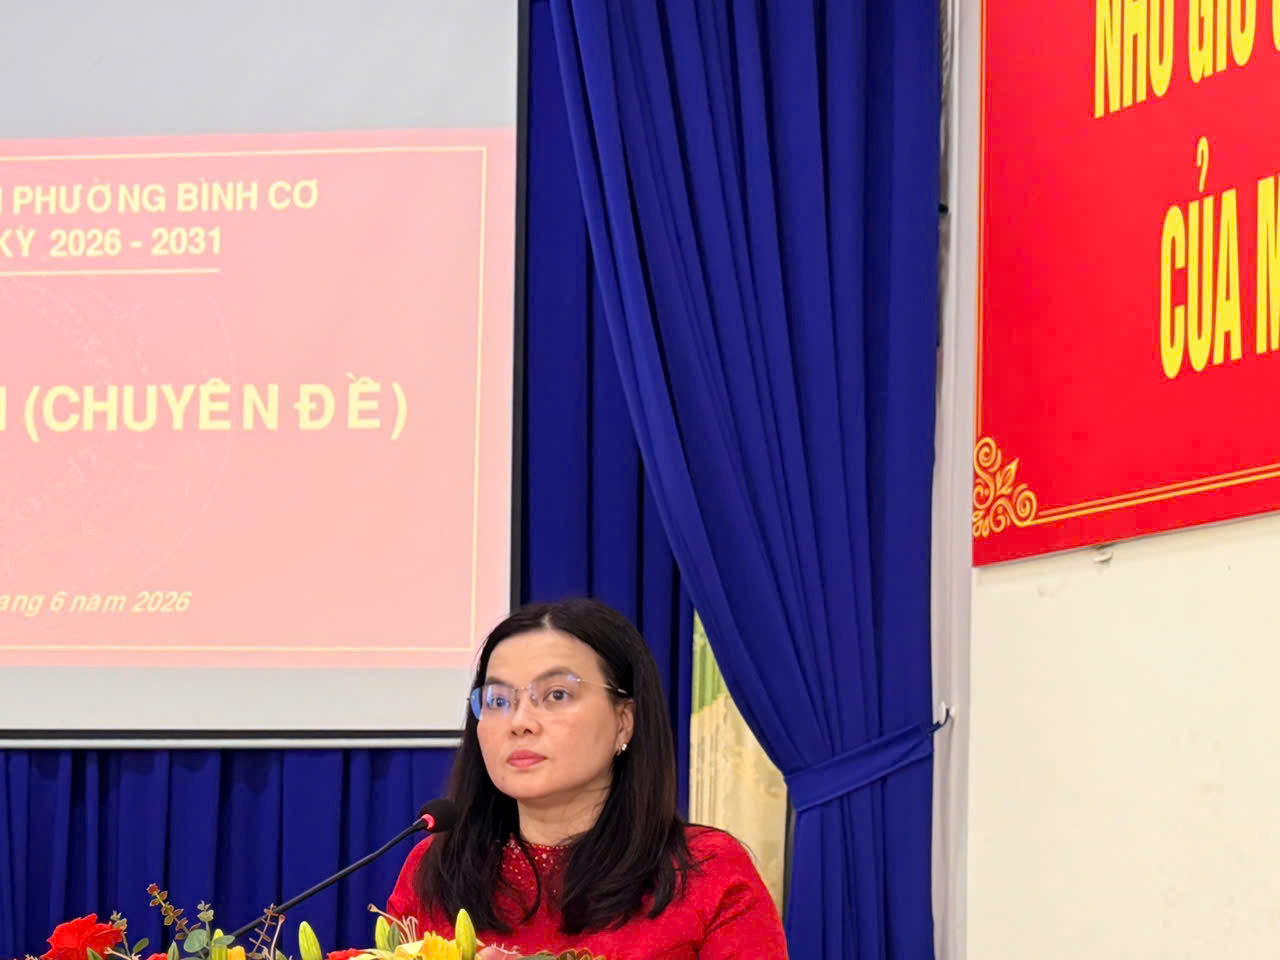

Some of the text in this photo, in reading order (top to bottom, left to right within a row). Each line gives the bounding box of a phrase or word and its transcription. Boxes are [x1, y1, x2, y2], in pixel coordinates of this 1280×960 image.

[268, 179, 320, 210] CƠ
[49, 228, 122, 258] 2026
[151, 226, 222, 256] 2031
[1159, 136, 1243, 380] CỦA
[24, 378, 280, 443] (CHUYÊN
[294, 372, 409, 441] ĐỀ)
[50, 591, 68, 613] 6
[131, 590, 193, 613] 2026
